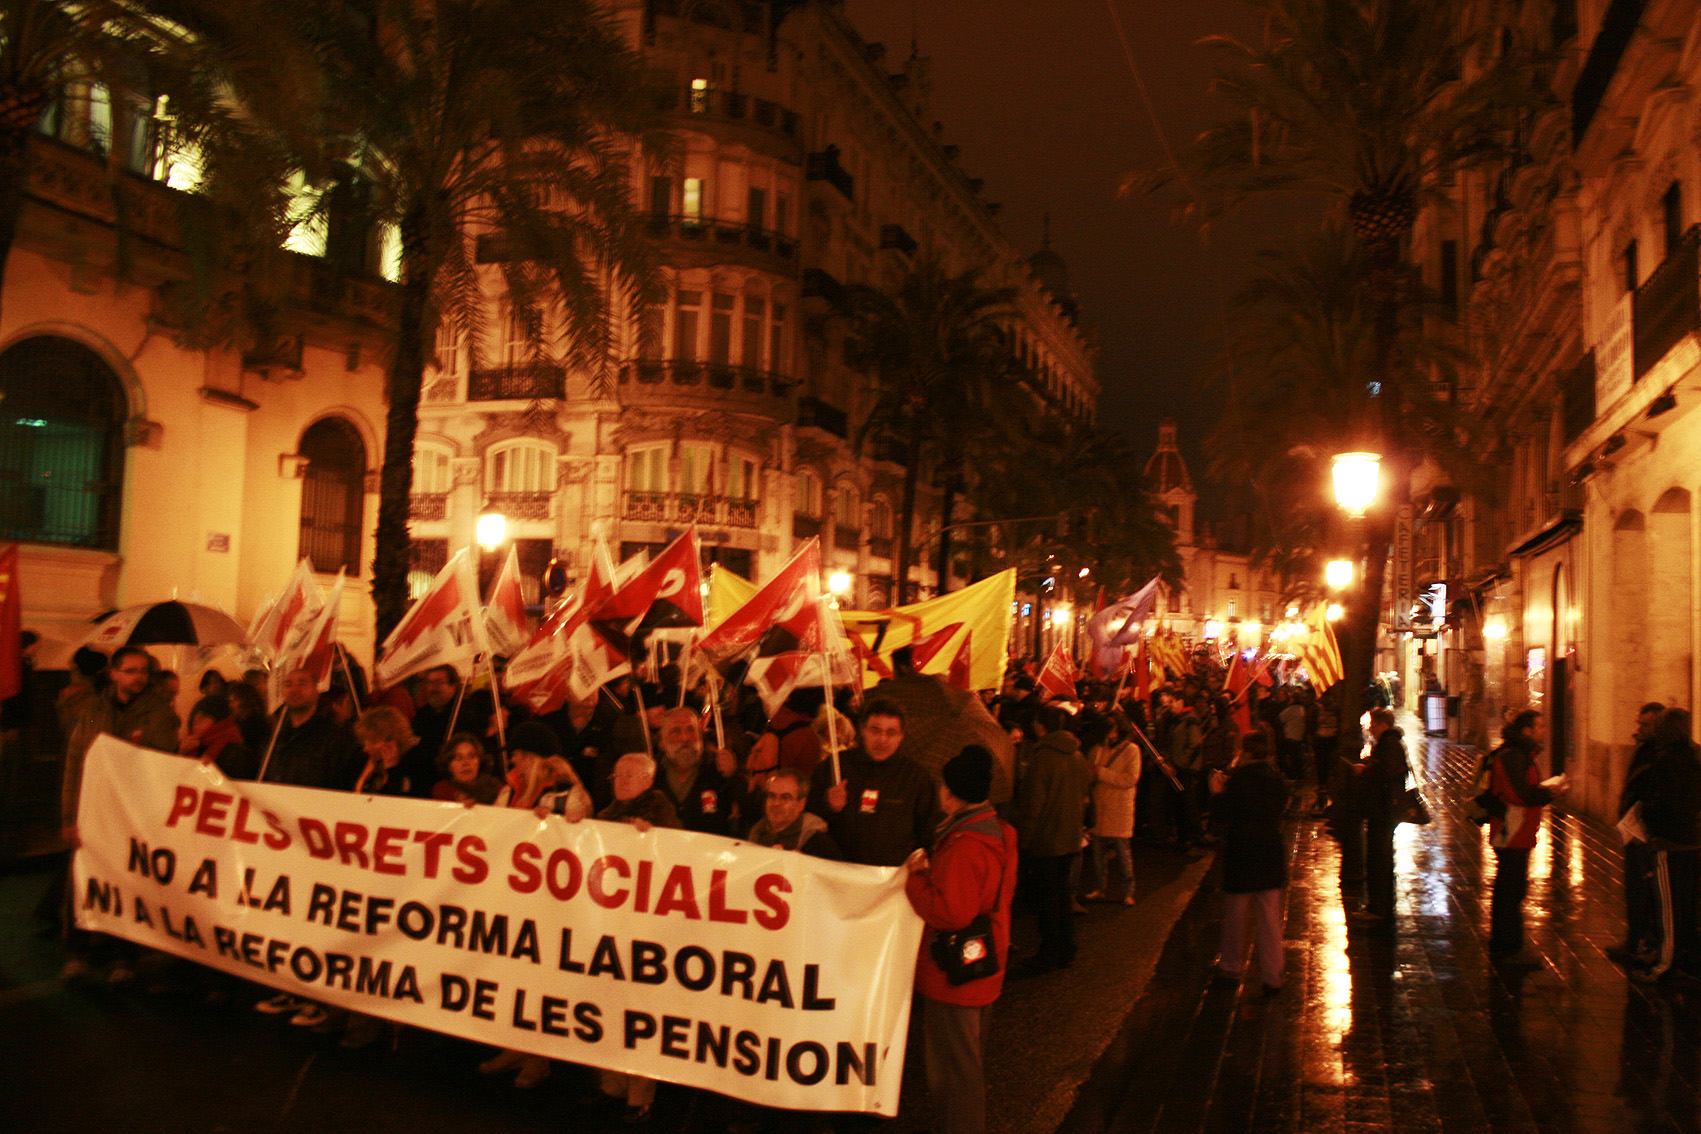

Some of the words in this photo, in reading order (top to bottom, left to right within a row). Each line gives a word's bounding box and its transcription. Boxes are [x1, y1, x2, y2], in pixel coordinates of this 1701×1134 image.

[1398, 503, 1412, 627] CAFETERIA
[128, 837, 176, 885] NO
[188, 859, 218, 899] A
[236, 867, 292, 916] LA
[306, 882, 541, 965] REFORMA
[558, 927, 836, 1011] LABORAL
[166, 785, 292, 851] PELS
[298, 816, 490, 885] DRETS
[507, 841, 793, 931] SOCIALS
[83, 877, 123, 917] NI
[134, 897, 154, 928] A
[160, 906, 205, 950] LA
[214, 926, 424, 1004] REFORMA
[440, 973, 498, 1021] DE
[512, 989, 603, 1043] LES
